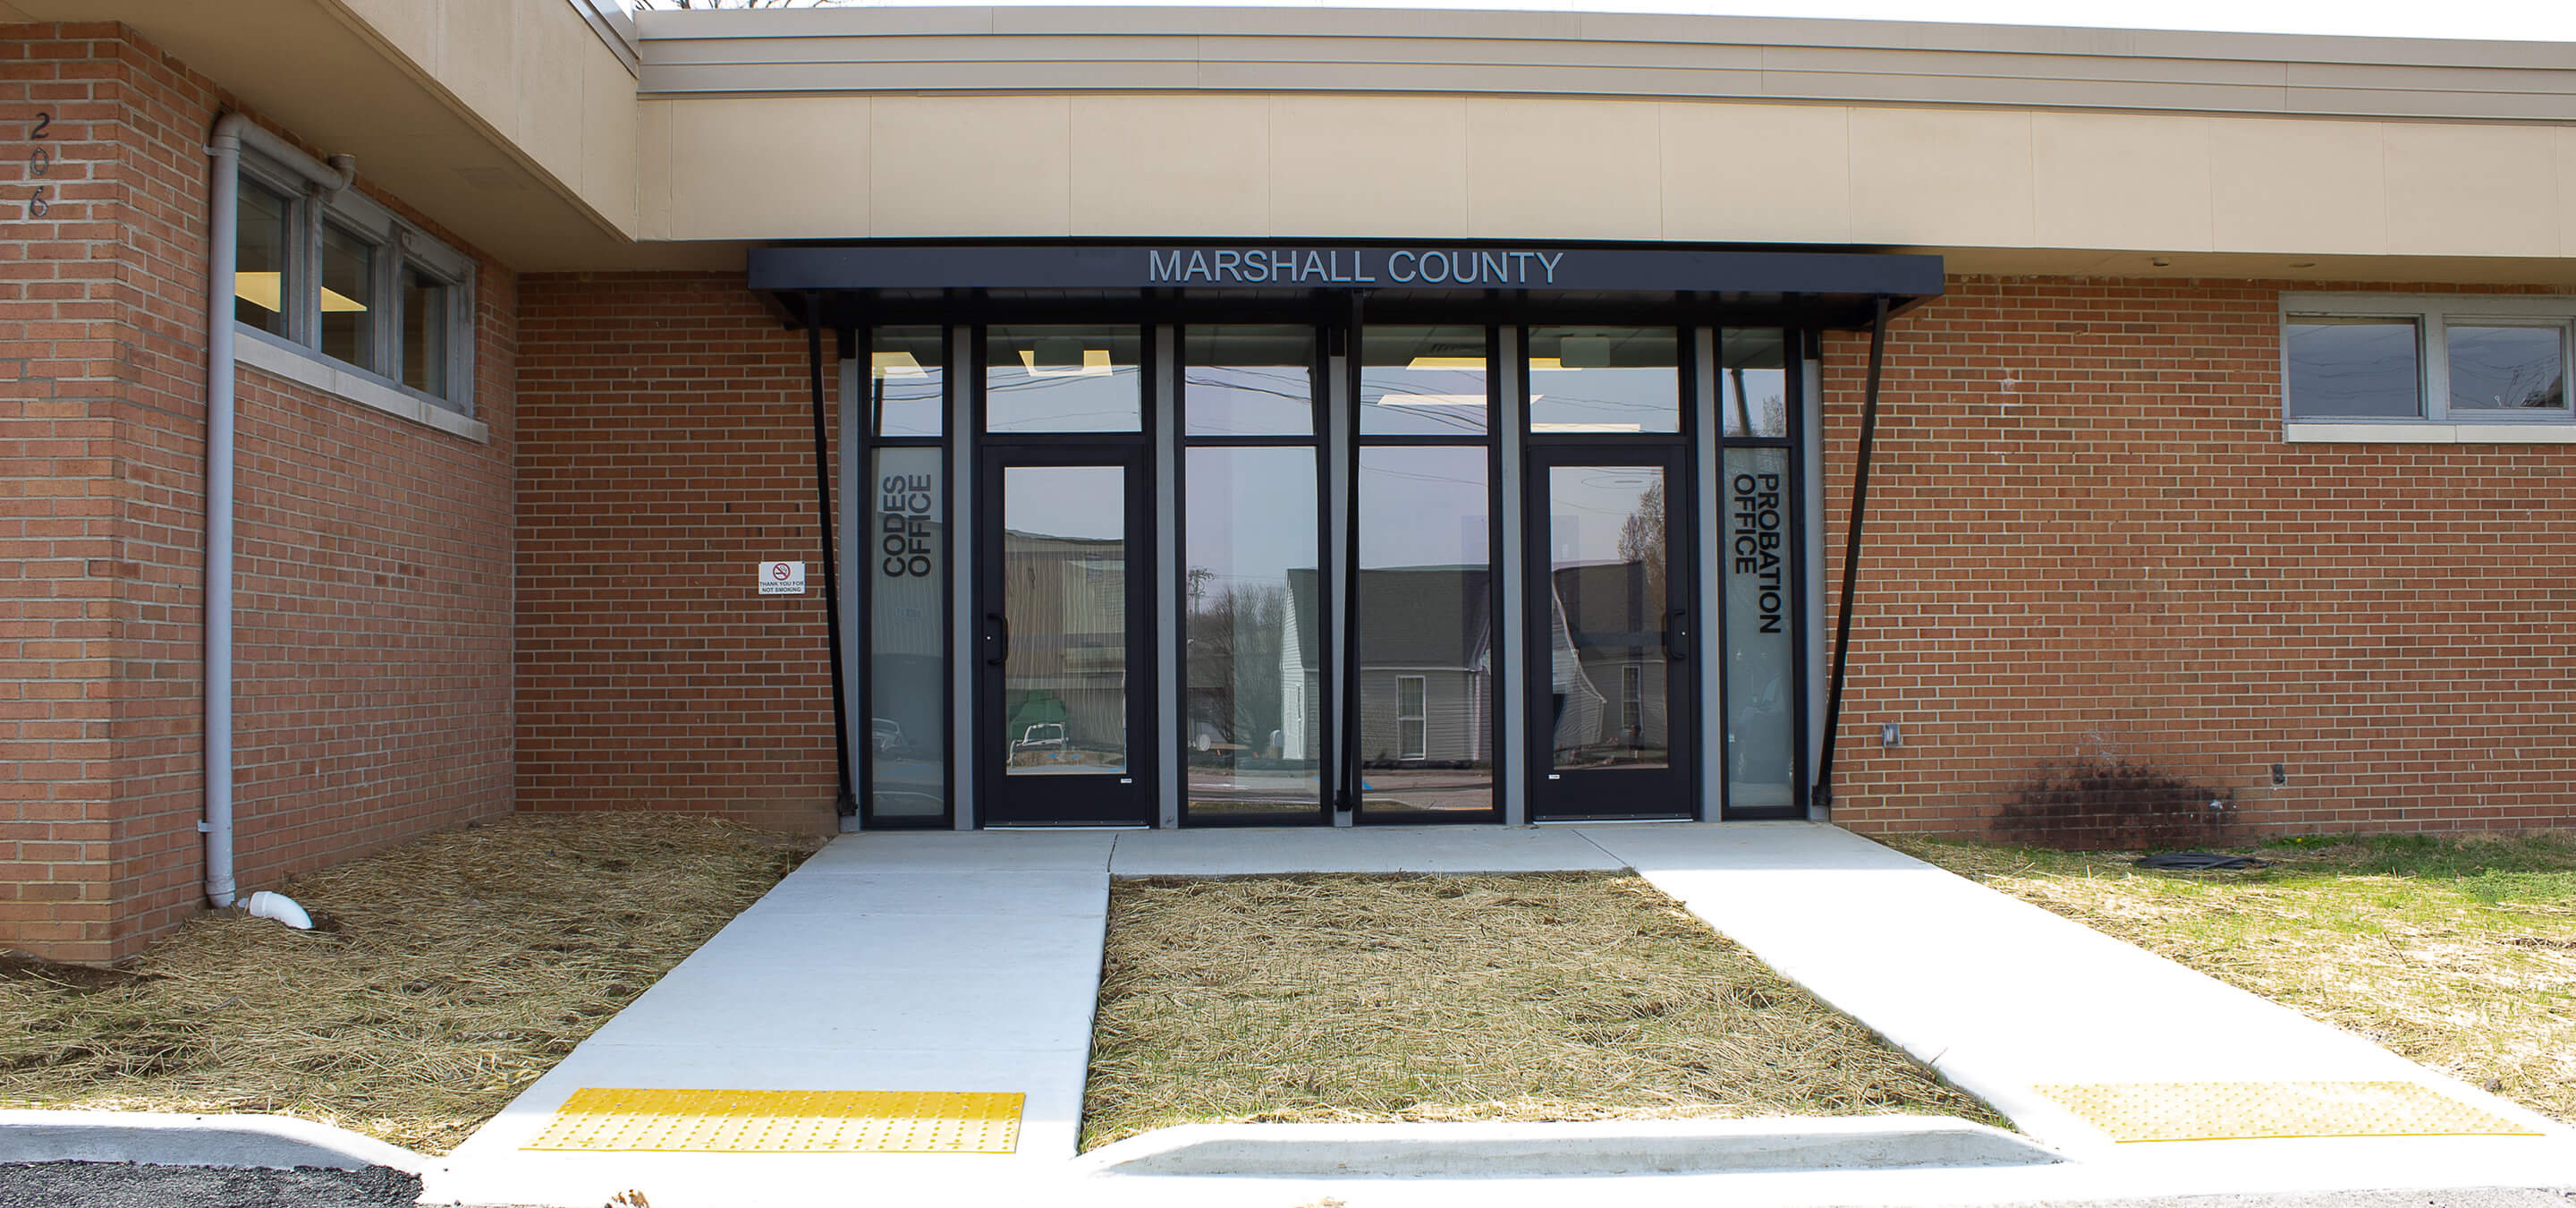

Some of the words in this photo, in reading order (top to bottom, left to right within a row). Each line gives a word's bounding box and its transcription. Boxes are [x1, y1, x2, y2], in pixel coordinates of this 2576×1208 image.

[30, 112, 51, 217] 206
[1149, 250, 1376, 284] MARSHALL
[1387, 251, 1564, 285] COUNTY
[882, 474, 906, 577] CODES
[908, 473, 932, 577] OFFICE
[1733, 473, 1758, 574] OFFICE
[1758, 473, 1782, 634] PROBATION
